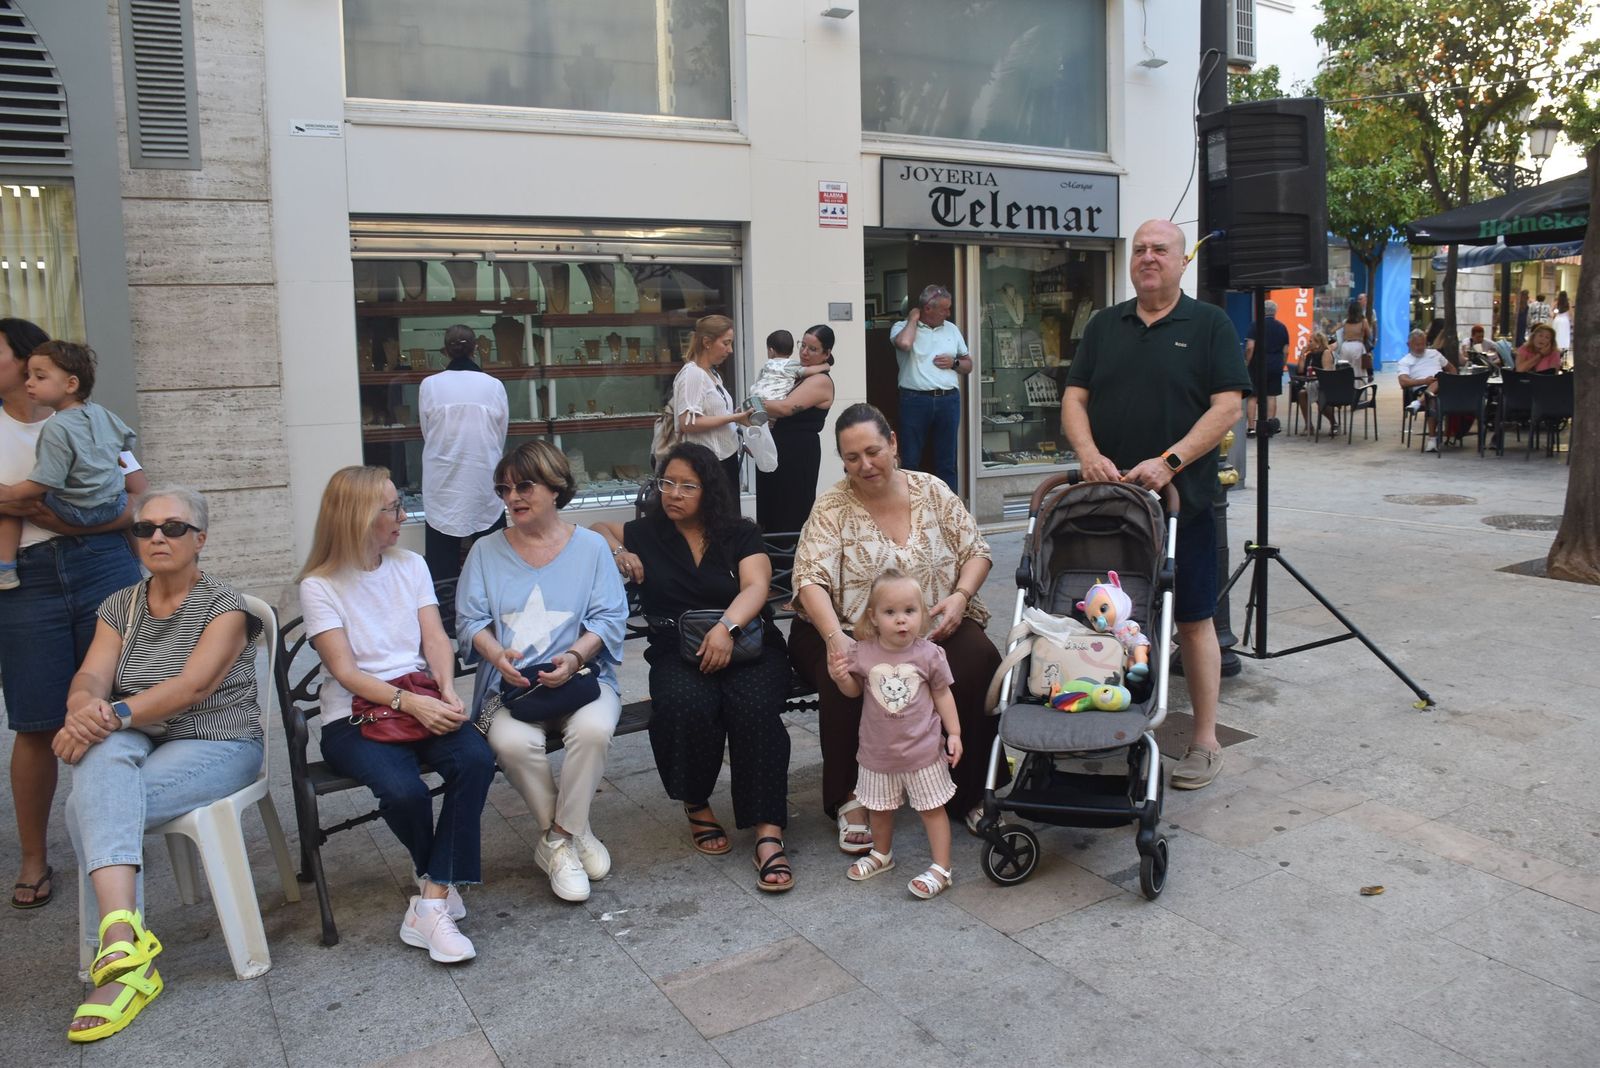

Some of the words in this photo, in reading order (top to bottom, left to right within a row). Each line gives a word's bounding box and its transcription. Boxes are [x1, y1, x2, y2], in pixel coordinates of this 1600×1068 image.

[899, 165, 999, 187] JOYERIA
[928, 186, 1103, 233] Telemar
[1478, 211, 1588, 239] Heineke
[1294, 323, 1310, 360] Toy
